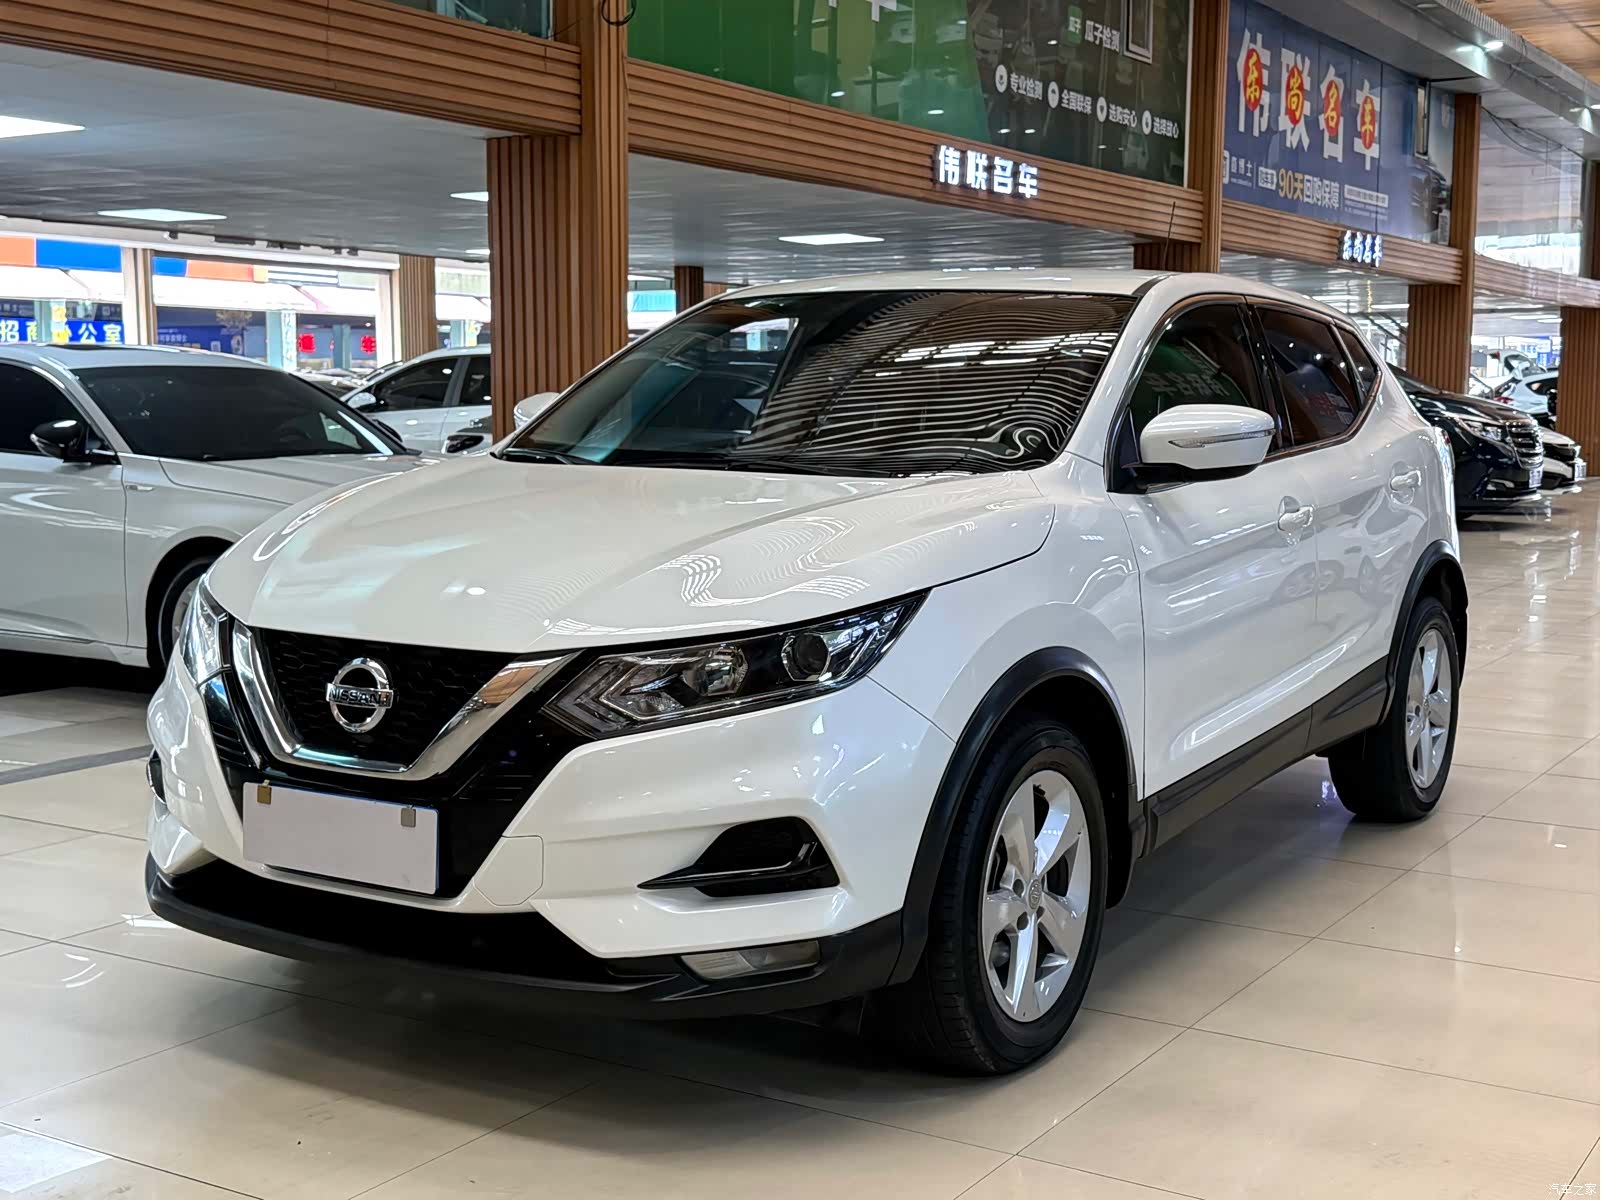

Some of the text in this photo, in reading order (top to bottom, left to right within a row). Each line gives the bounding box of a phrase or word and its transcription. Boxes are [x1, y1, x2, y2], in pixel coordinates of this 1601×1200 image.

[1010, 72, 1043, 100] 专业检测
[1061, 89, 1092, 115] 全国联保
[939, 145, 1038, 198] 伟联名车
[1278, 168, 1340, 210] 90天回购保障
[329, 687, 382, 705] NISSAN
